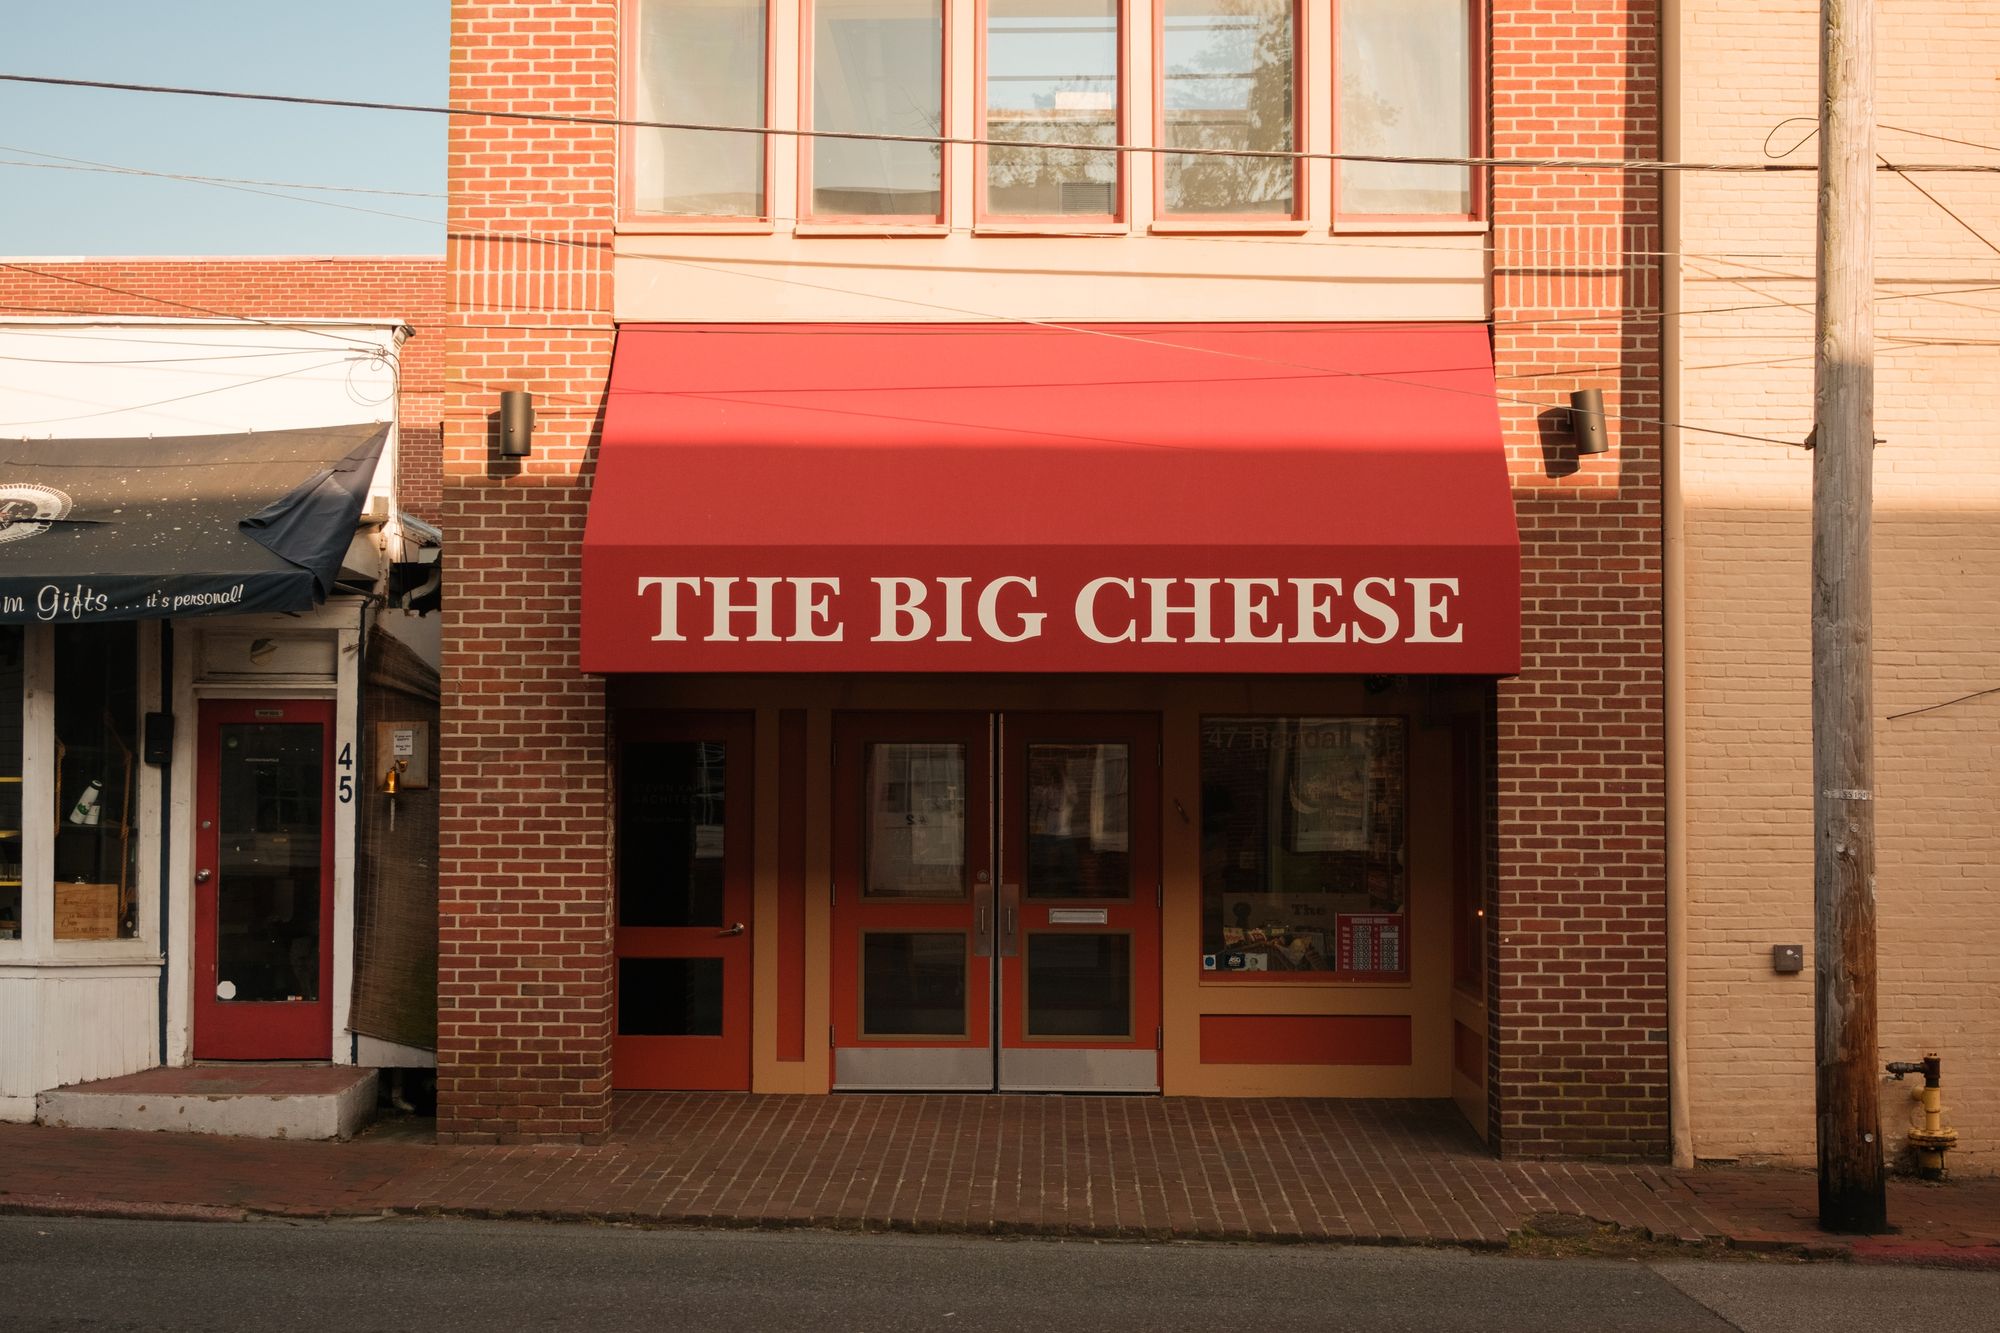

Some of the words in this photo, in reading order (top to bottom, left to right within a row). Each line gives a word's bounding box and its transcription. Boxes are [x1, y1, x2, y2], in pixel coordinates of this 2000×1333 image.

[174, 584, 244, 611] personal!
[638, 576, 843, 642] THE
[871, 576, 1047, 643] BIG
[1075, 576, 1464, 644] CHEESE
[1207, 726, 1239, 749] 47
[1249, 726, 1352, 750] Randall
